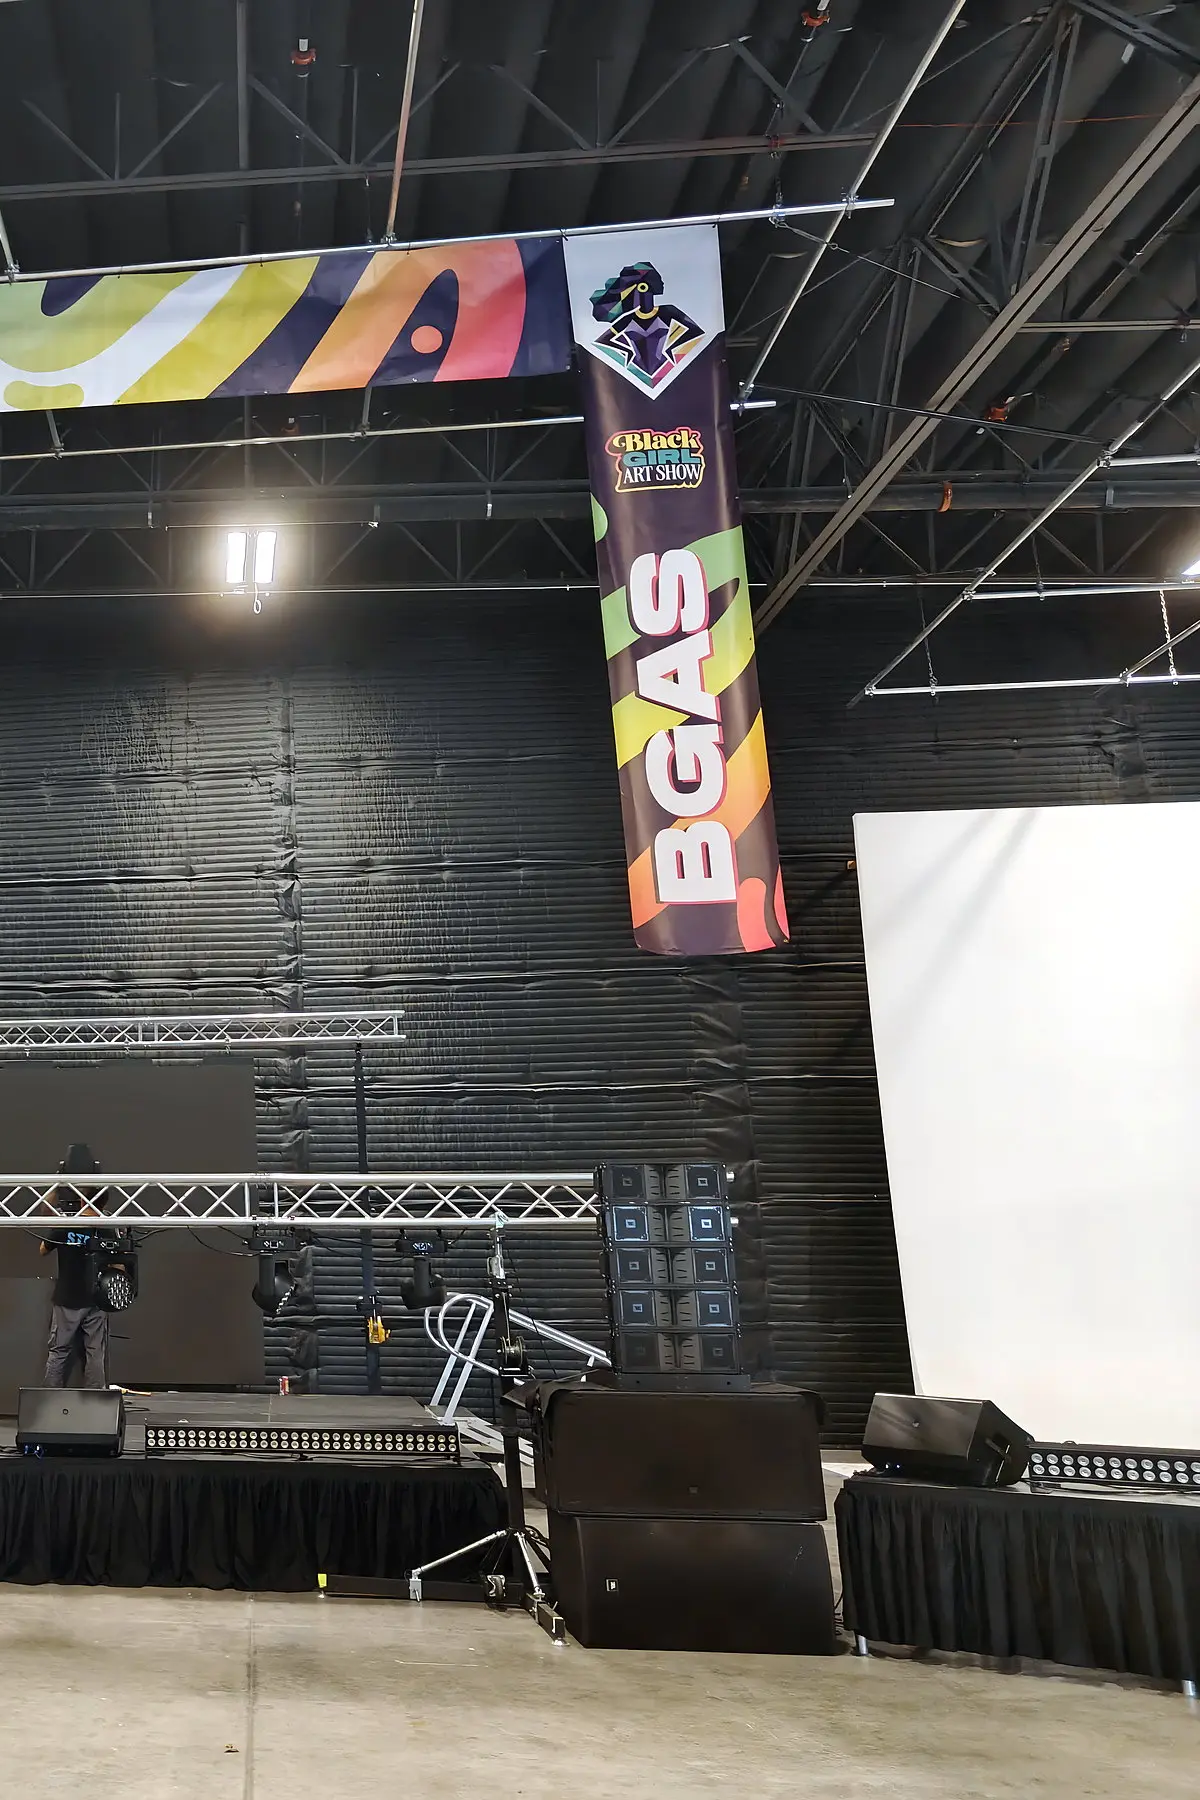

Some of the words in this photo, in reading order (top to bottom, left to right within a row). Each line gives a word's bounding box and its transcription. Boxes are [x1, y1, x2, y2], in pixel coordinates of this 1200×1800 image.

[612, 430, 700, 452] Black
[622, 448, 701, 467] GIRL
[623, 466, 654, 484] ART
[655, 464, 701, 481] SHOW
[629, 549, 737, 903] BGAS
